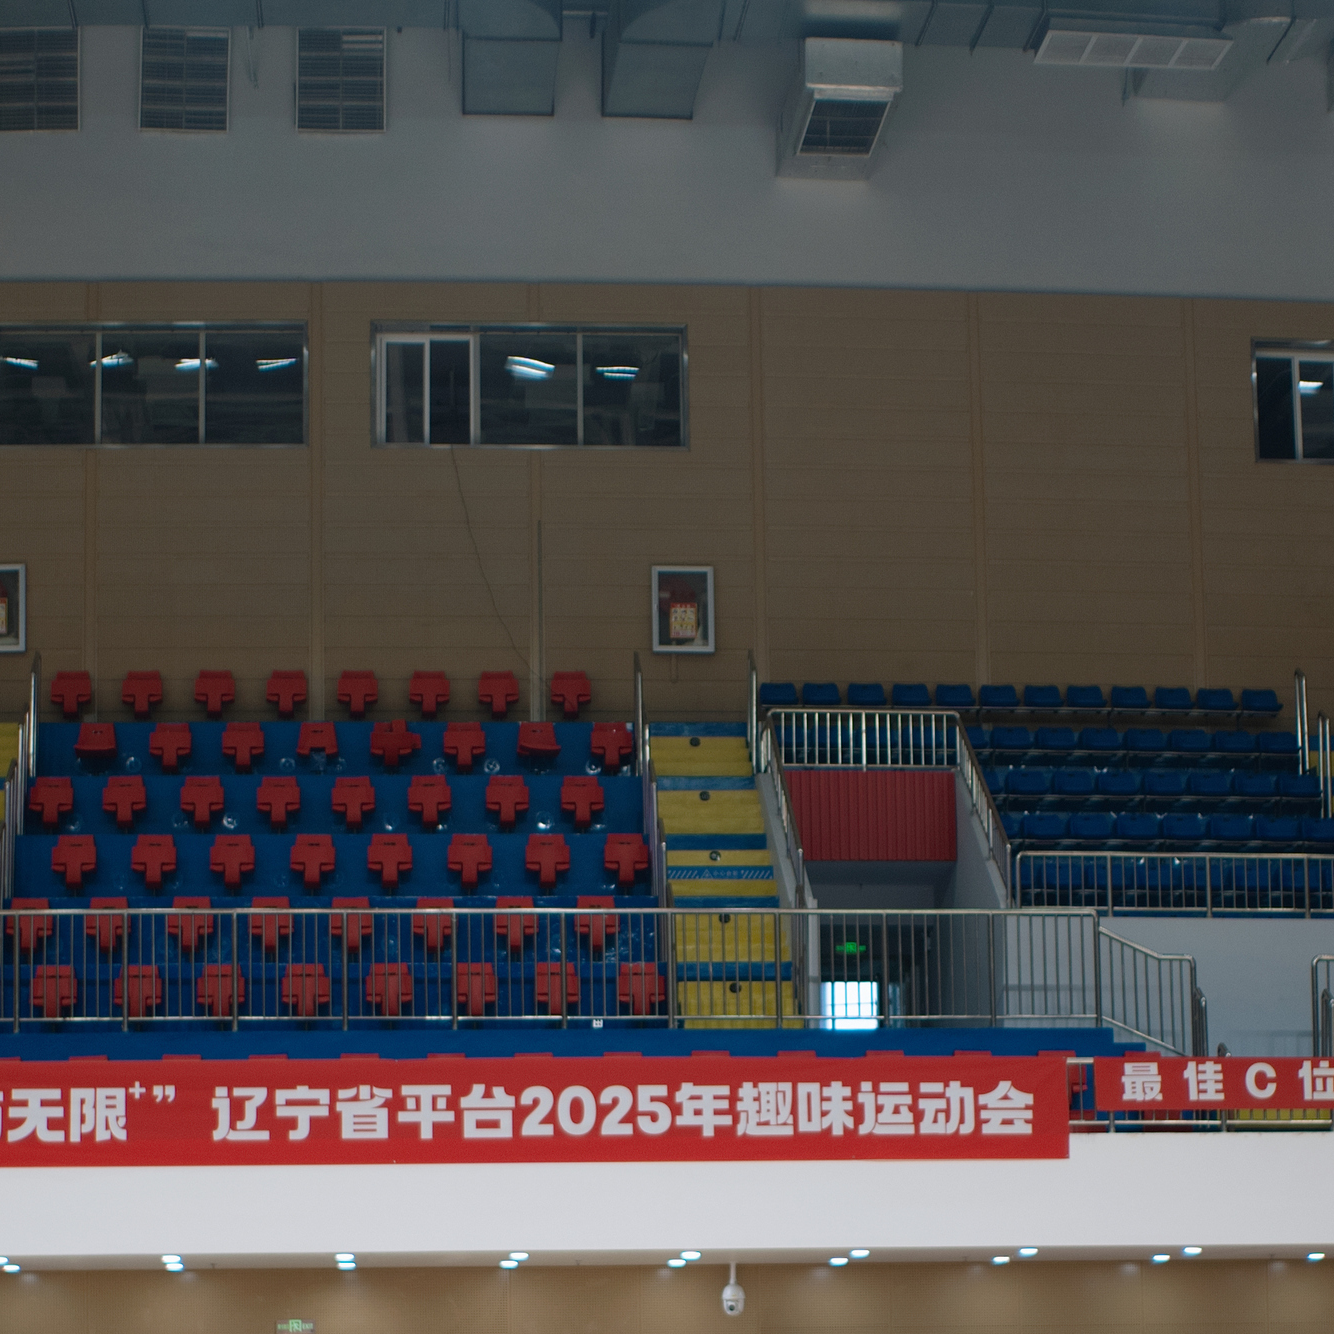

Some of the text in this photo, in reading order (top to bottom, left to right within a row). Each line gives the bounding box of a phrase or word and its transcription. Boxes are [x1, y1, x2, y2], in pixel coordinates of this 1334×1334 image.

[211, 1080, 1035, 1142] 辽宁省平台2025年趣味运动会
